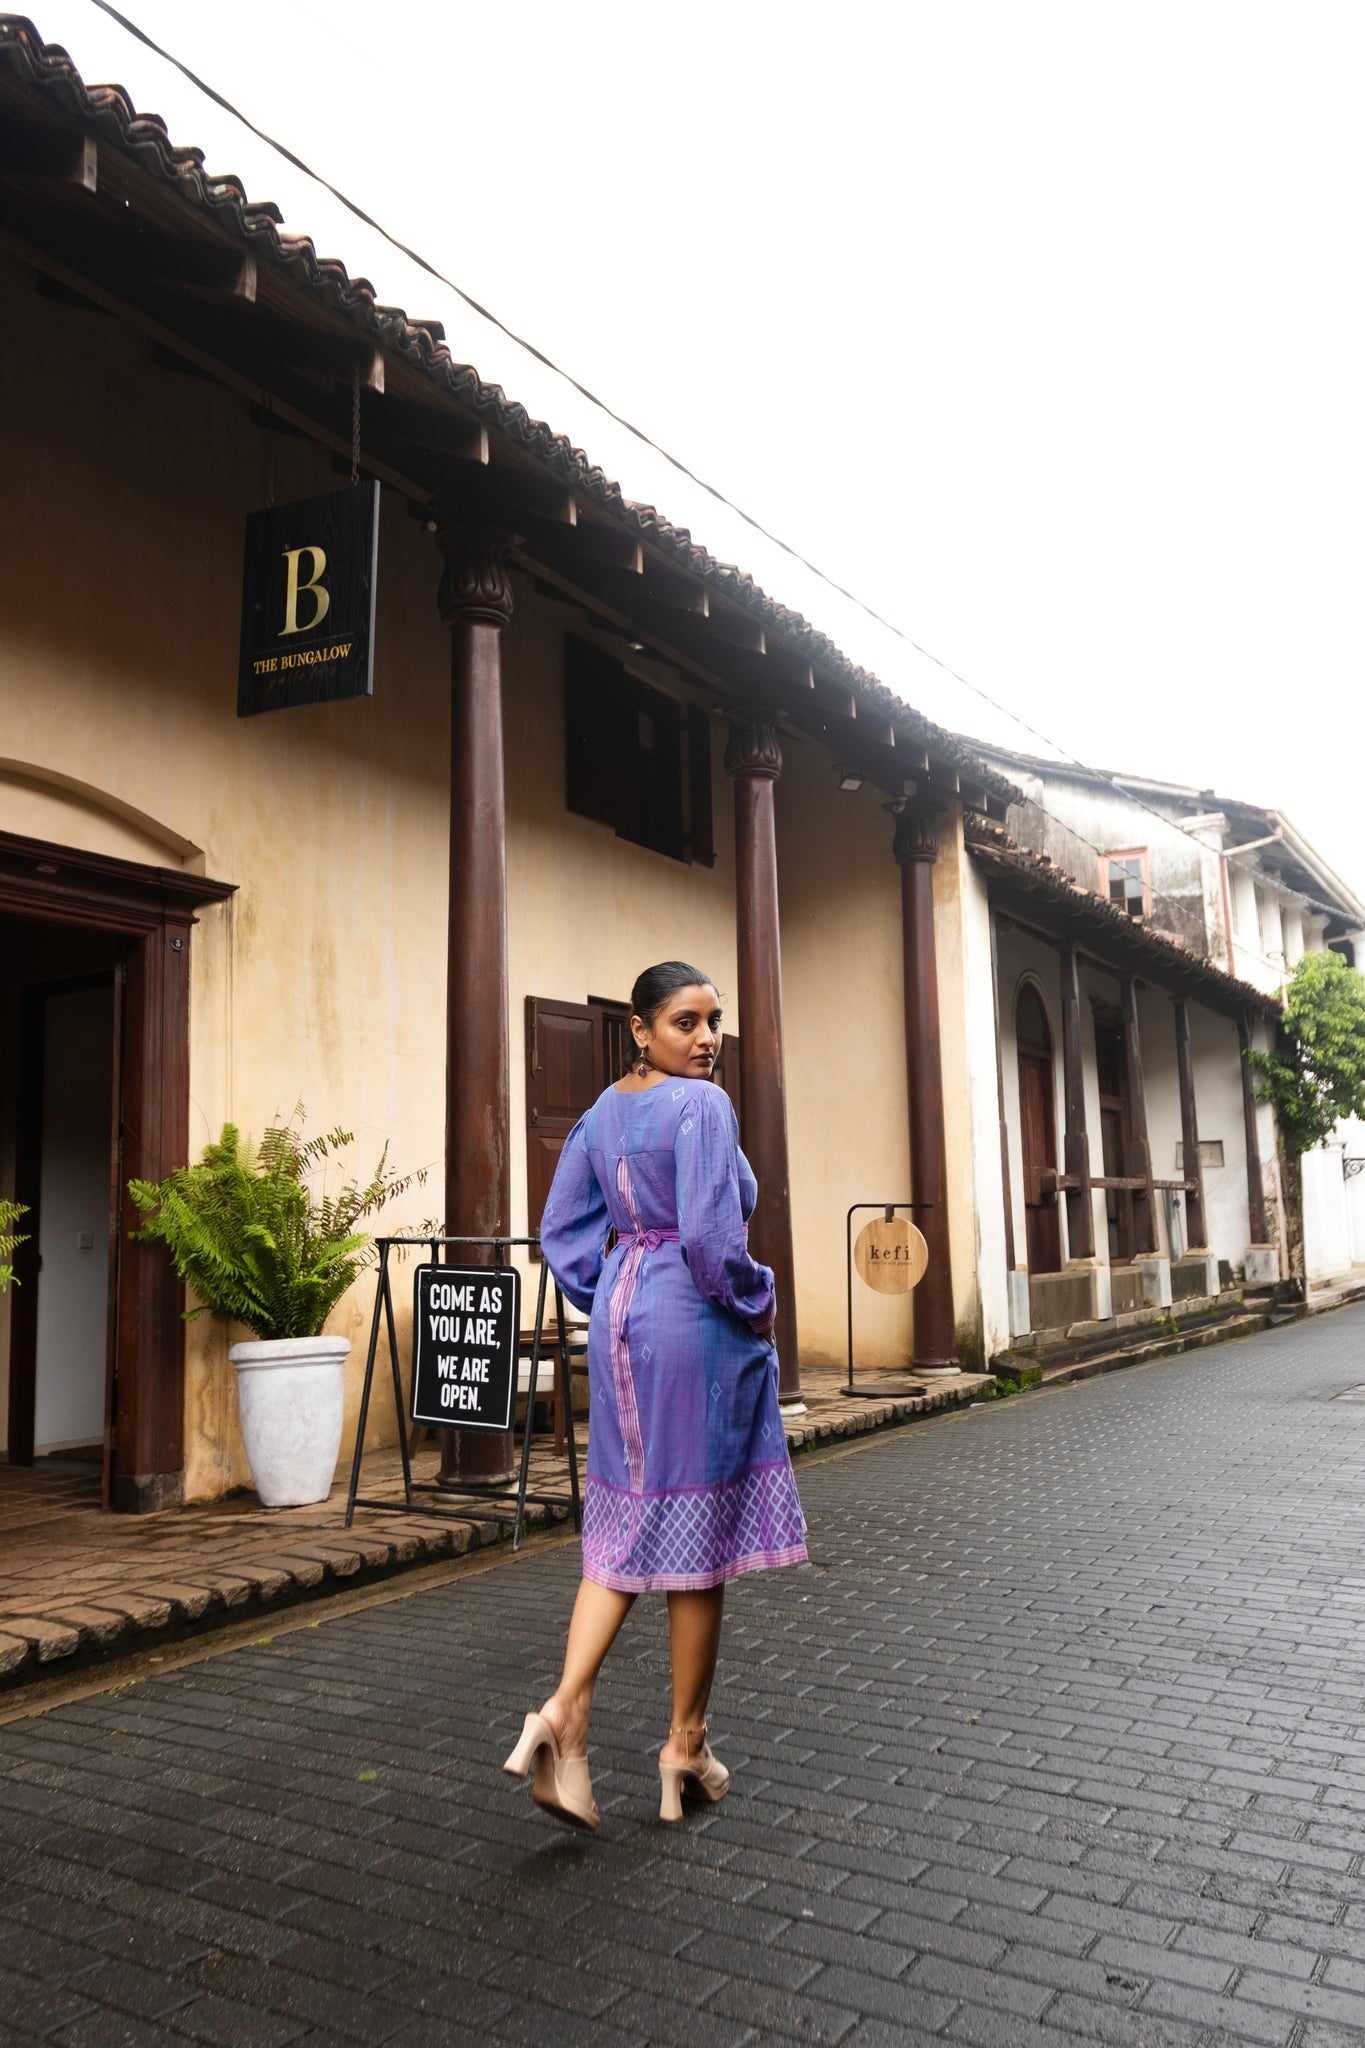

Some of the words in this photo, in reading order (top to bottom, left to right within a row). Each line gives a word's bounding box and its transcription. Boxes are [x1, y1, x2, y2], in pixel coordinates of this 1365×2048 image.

[278, 546, 330, 636] B
[253, 658, 278, 675] THE
[281, 643, 352, 670] BUNGALOW
[870, 1245, 910, 1260] kefi
[429, 1284, 475, 1312] COME
[479, 1286, 502, 1313] AS
[429, 1315, 460, 1343] YOU
[464, 1318, 501, 1349] ARE,
[437, 1354, 458, 1379] WE
[461, 1357, 490, 1382] ARE
[440, 1383, 482, 1411] OPEN.
